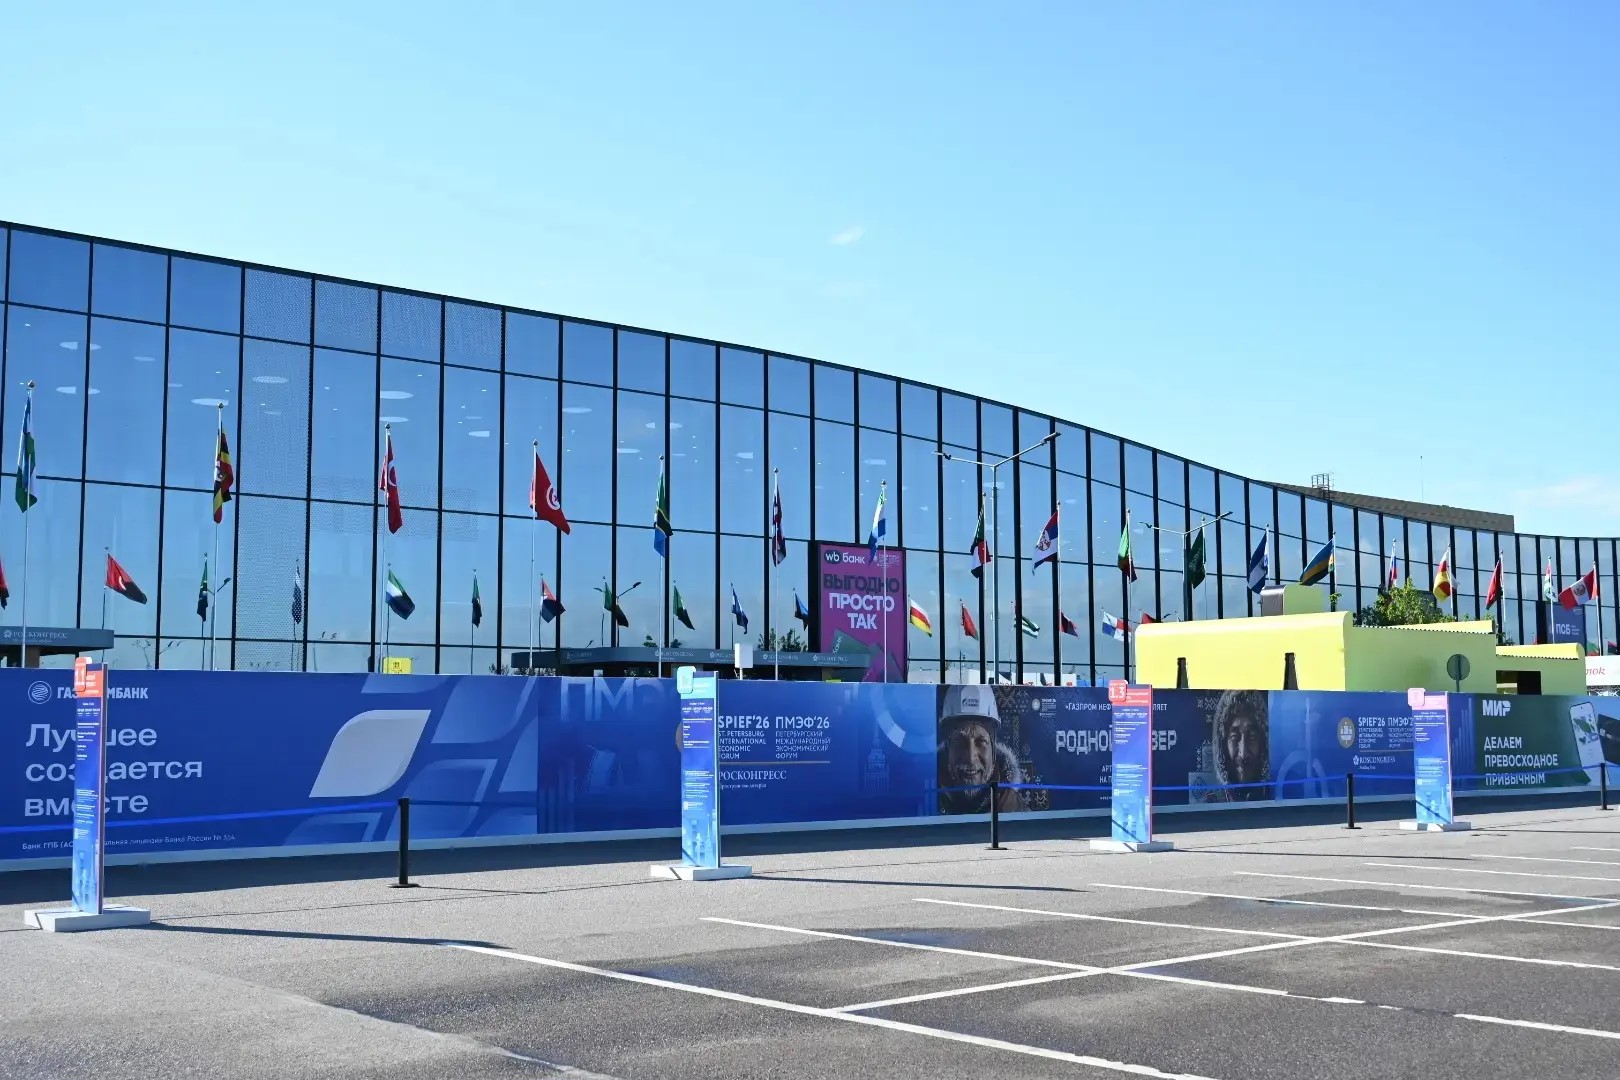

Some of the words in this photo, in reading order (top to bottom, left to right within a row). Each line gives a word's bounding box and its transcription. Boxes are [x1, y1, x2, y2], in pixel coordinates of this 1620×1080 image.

[826, 551, 840, 562] wb
[842, 552, 866, 564] банк
[823, 573, 900, 594] ВЫГОДНО
[829, 592, 895, 612] ПРОСТО
[847, 612, 878, 630] ТАК
[1555, 623, 1571, 635] ПСБ
[1109, 686, 1125, 699] 1.3
[1482, 699, 1511, 717] МИР
[1387, 716, 1413, 727] ПМЭФ'2
[1484, 736, 1522, 751] ДЕЛАЕМ
[1485, 754, 1559, 768] ПРЕВОСХОДНОЕ
[1485, 772, 1545, 786] ПРИВЫЧНЫМ
[43, 841, 59, 849] ГПБ
